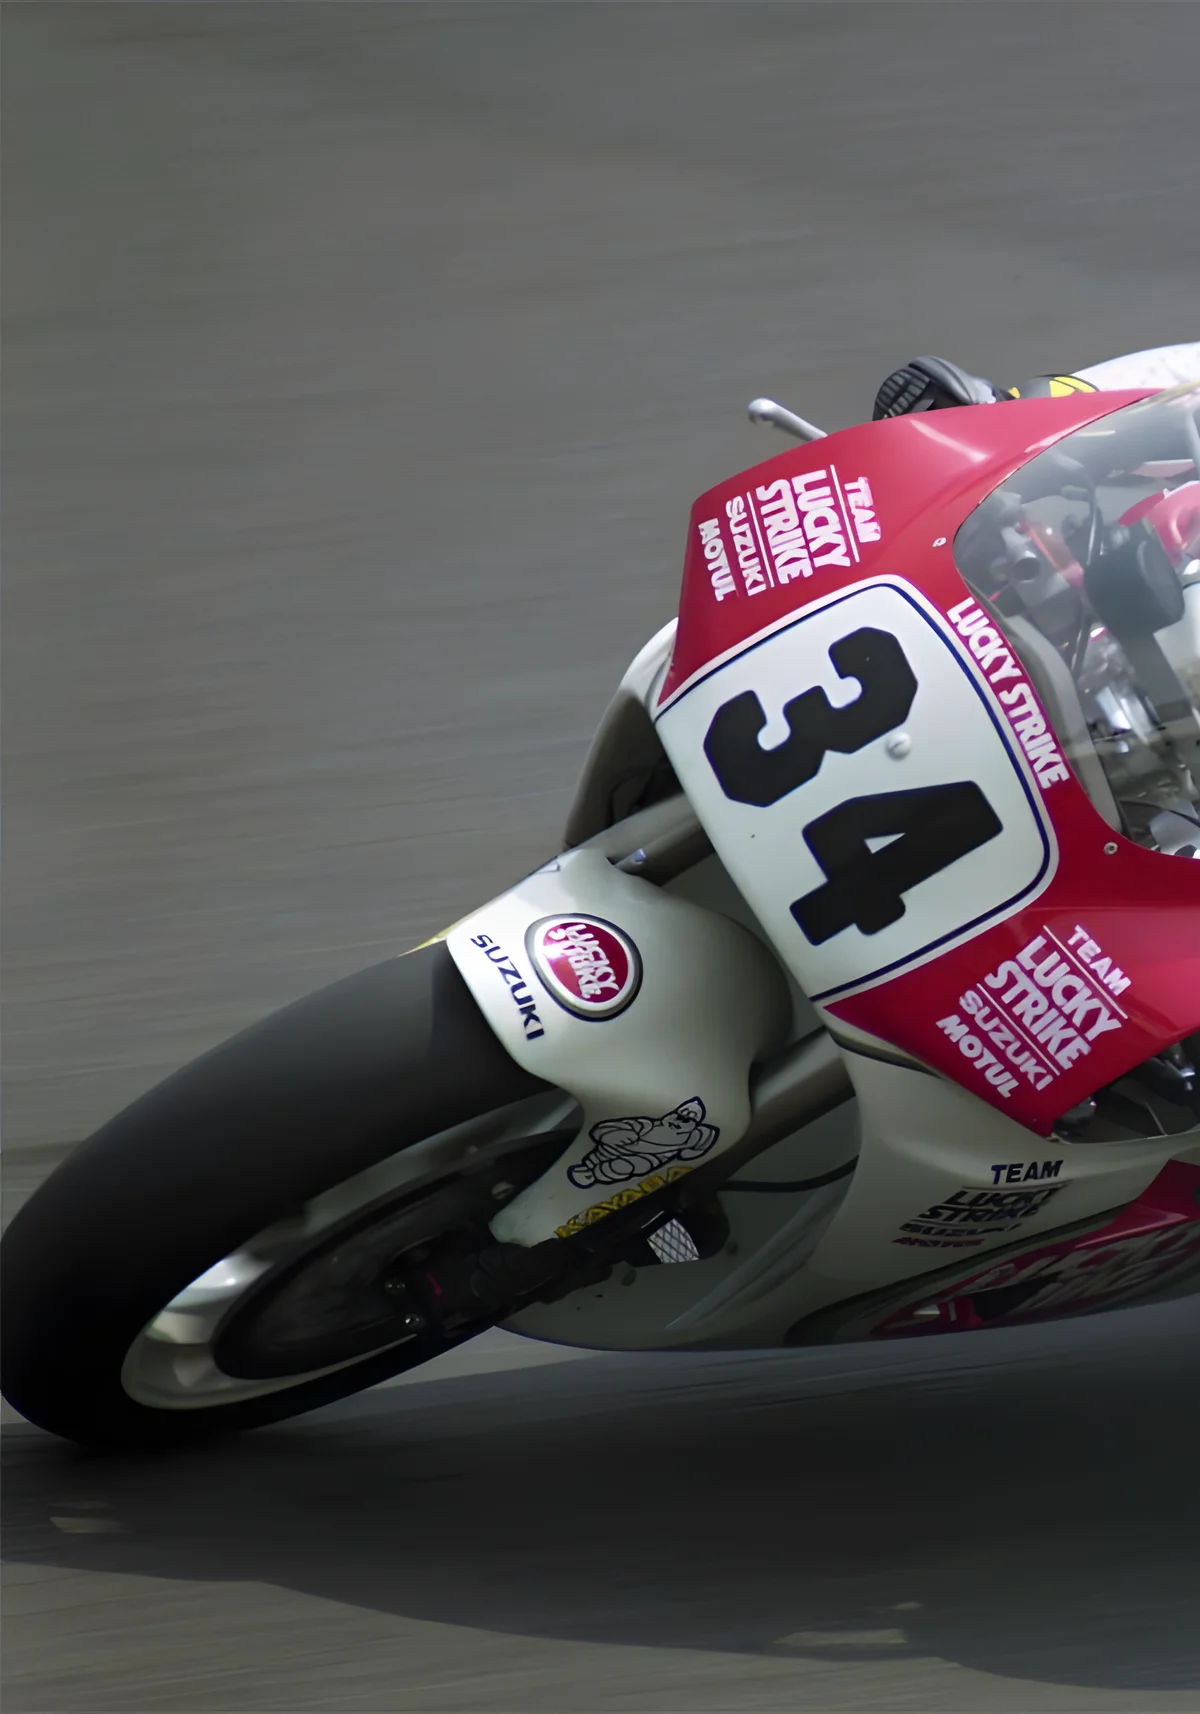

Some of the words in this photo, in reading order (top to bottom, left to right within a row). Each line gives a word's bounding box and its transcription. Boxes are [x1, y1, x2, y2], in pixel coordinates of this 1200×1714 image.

[698, 517, 736, 602] MOTUL
[725, 495, 767, 596] SUZUKI
[755, 478, 813, 585] STRIKE
[793, 469, 851, 568] LUCKY
[843, 476, 881, 544] TEAM
[946, 596, 1022, 683] LUCKY
[998, 683, 1070, 790] STRIKE
[704, 625, 1003, 947] 34
[470, 934, 545, 1041] SUZUKI
[1015, 935, 1122, 1041] LUCKY
[1067, 924, 1132, 996] TEAM
[936, 1015, 1020, 1099] MOTUL
[959, 990, 1054, 1091] SUZUKI
[984, 960, 1091, 1070] STRIKE
[991, 1160, 1063, 1185] TEAM
